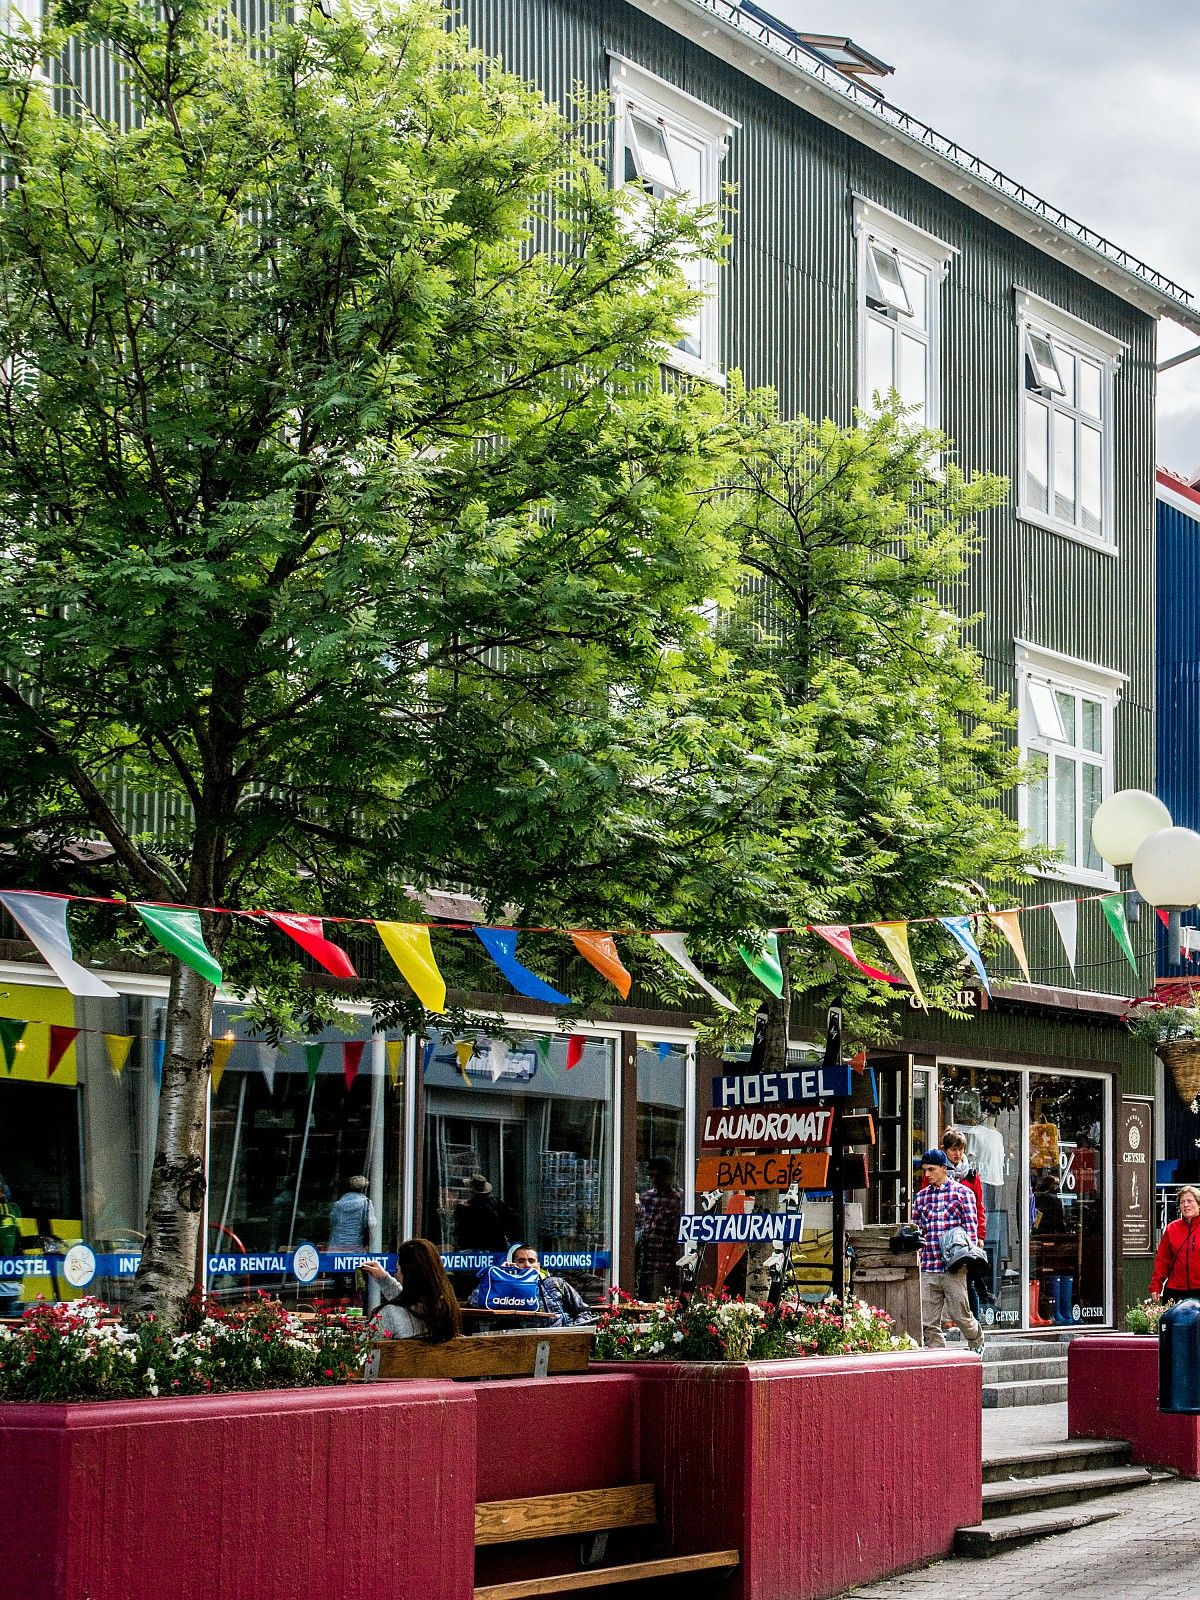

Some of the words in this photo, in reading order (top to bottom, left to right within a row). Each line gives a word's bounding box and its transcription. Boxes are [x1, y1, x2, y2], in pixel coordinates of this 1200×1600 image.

[722, 1069, 834, 1106] HOSTEL
[704, 1111, 831, 1141] LAUNDROMAT
[1123, 1152, 1145, 1163] GEYSIR
[678, 1214, 801, 1241] RESTAURANT
[119, 1257, 141, 1272] INF
[208, 1257, 236, 1272] CAR
[240, 1256, 286, 1271] RENTAL
[440, 1255, 494, 1268] DVENTURE
[543, 1254, 592, 1267] BOOKINGS
[492, 1296, 526, 1307] adidas
[995, 1310, 1020, 1322] GEYSIR
[1081, 1307, 1104, 1318] GEYSIR
